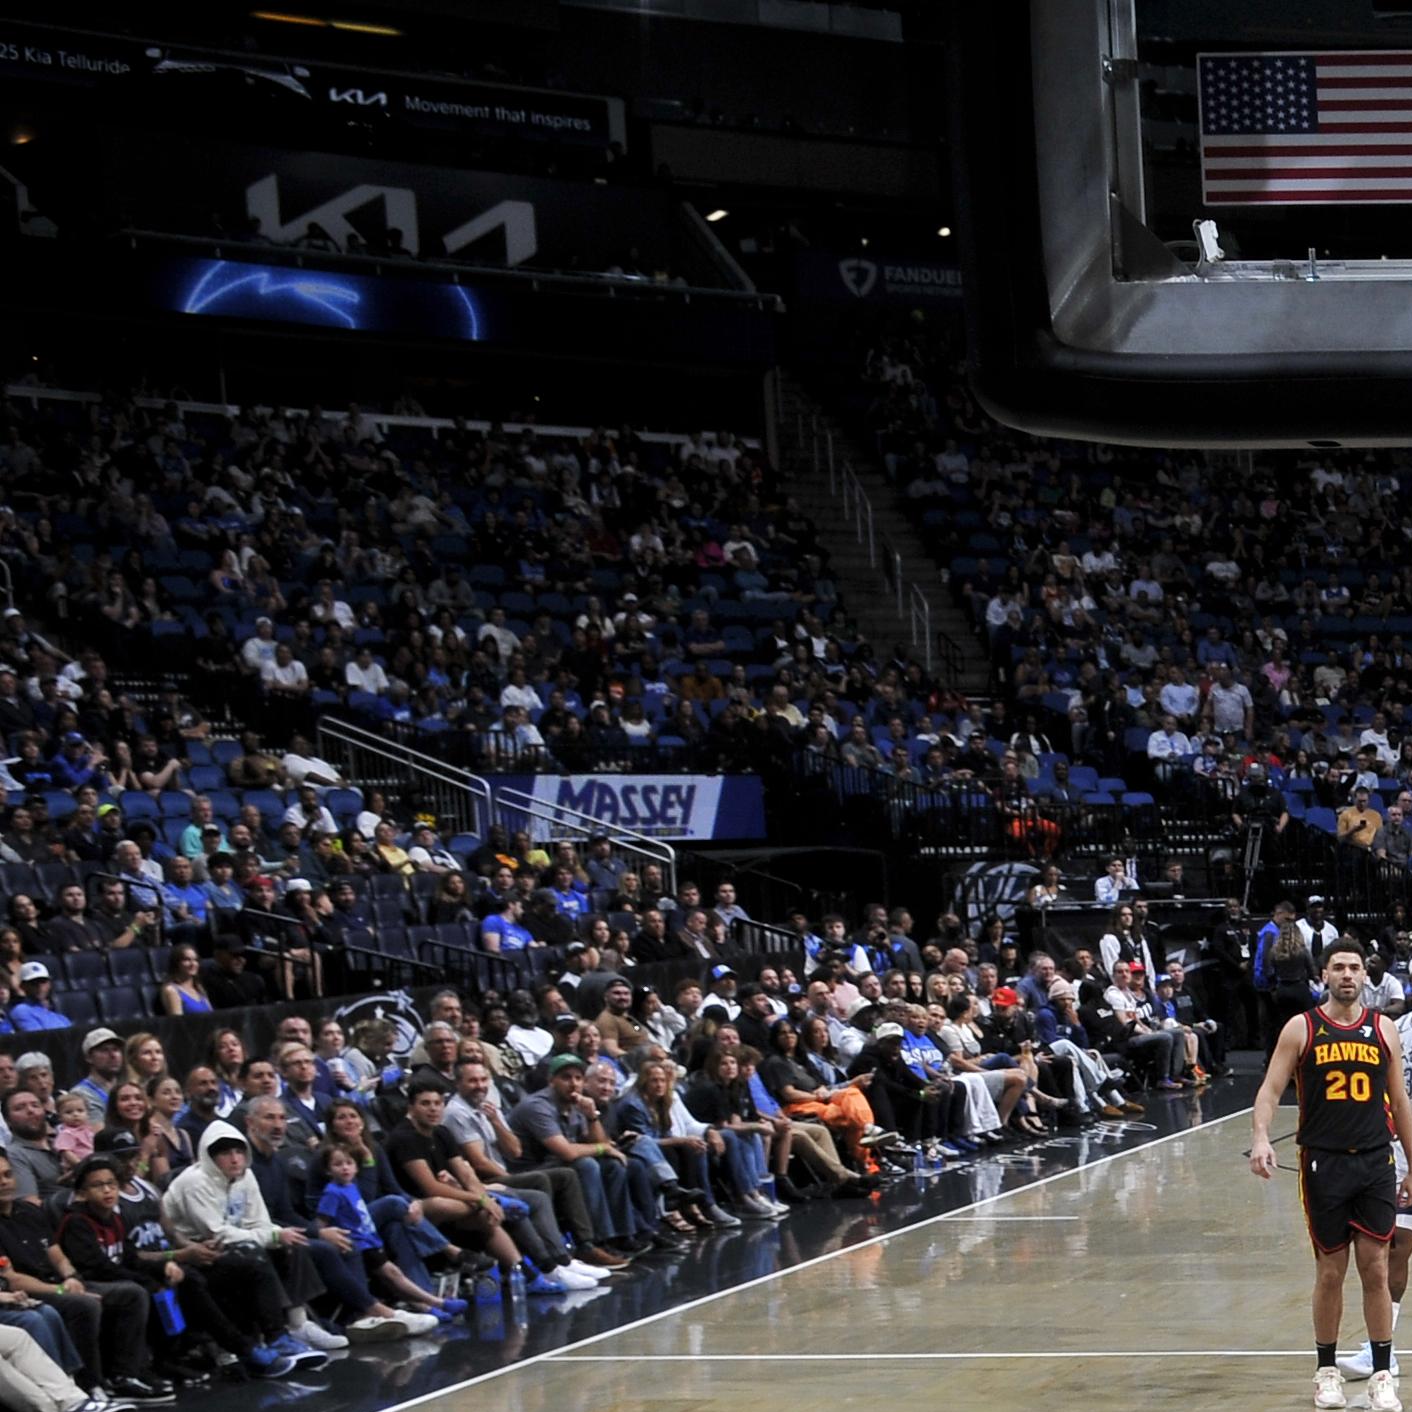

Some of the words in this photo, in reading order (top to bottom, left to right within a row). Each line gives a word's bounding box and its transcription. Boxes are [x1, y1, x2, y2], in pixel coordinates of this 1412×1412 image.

[24, 46, 52, 64] Kia
[58, 50, 131, 75] Telluride
[404, 95, 490, 120] Movement
[495, 102, 526, 124] that
[531, 111, 592, 133] inspires
[554, 779, 696, 826] MASSEY
[1314, 1042, 1380, 1066] HAWKS
[1325, 1070, 1371, 1101] 20
